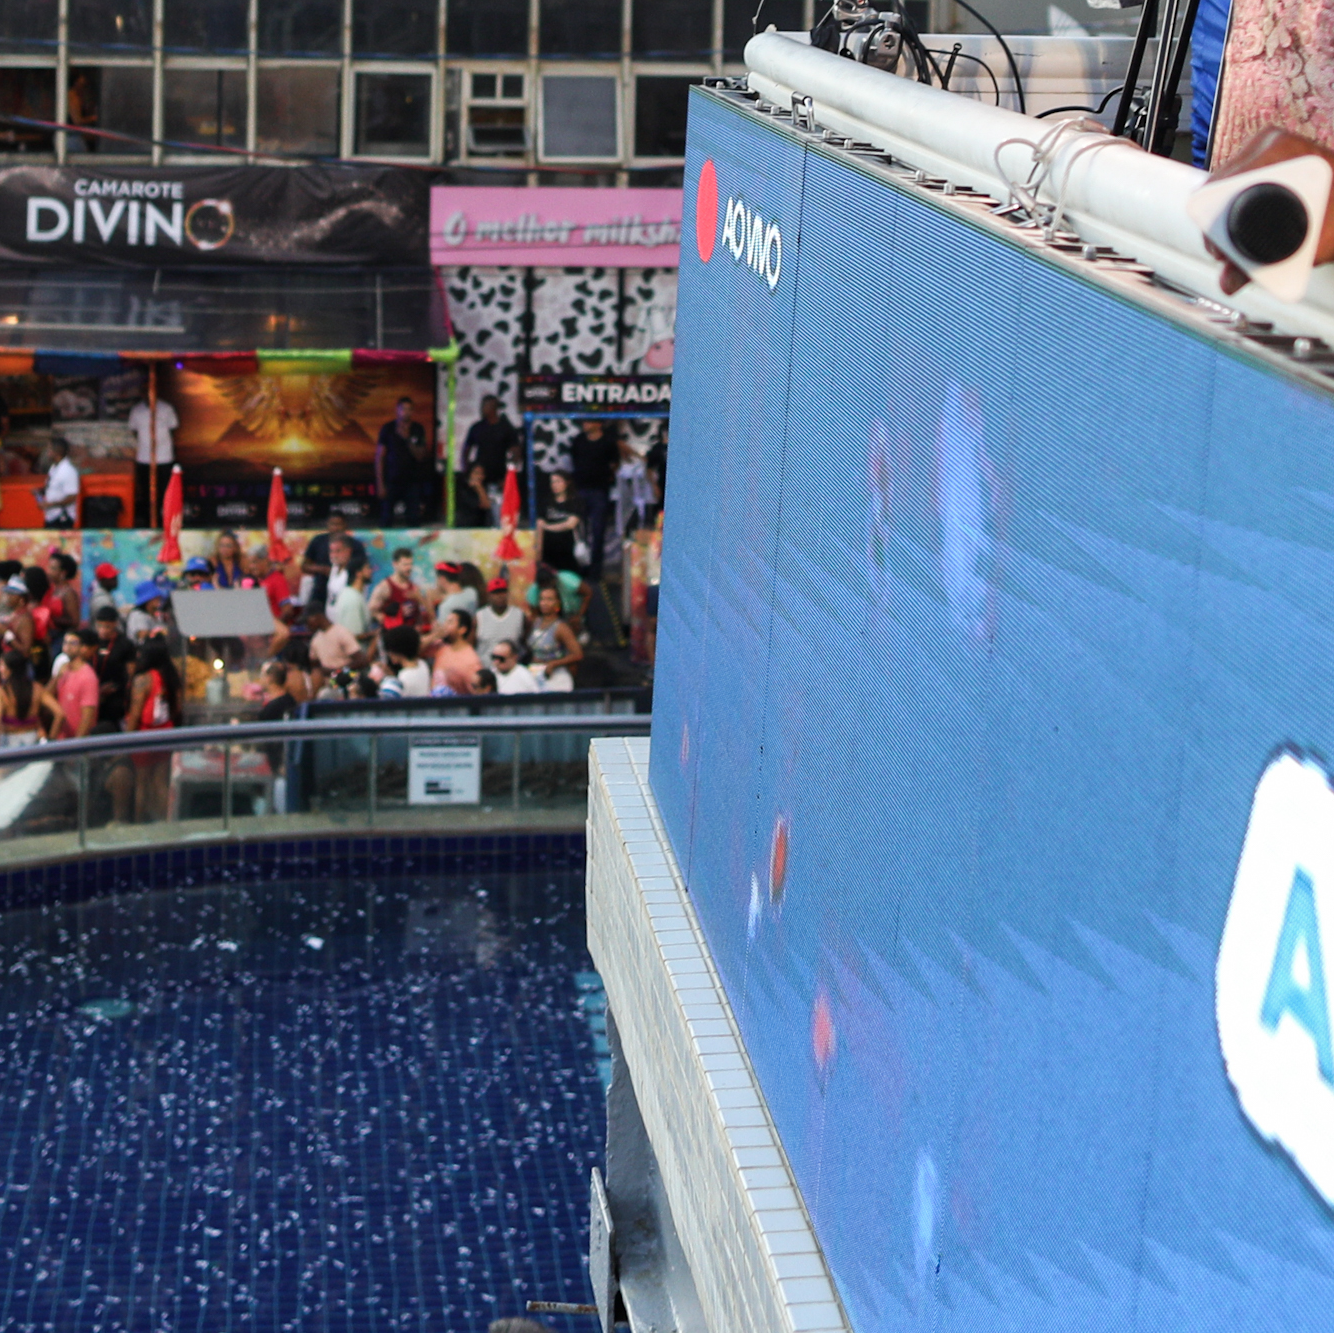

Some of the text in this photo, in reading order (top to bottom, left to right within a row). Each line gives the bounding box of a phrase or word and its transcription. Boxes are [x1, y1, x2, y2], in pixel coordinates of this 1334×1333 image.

[74, 178, 184, 199] CAMAROTE
[26, 196, 235, 251] DIVINO
[443, 210, 466, 246] O
[474, 212, 575, 244] melhor
[562, 381, 671, 403] ENTRADA
